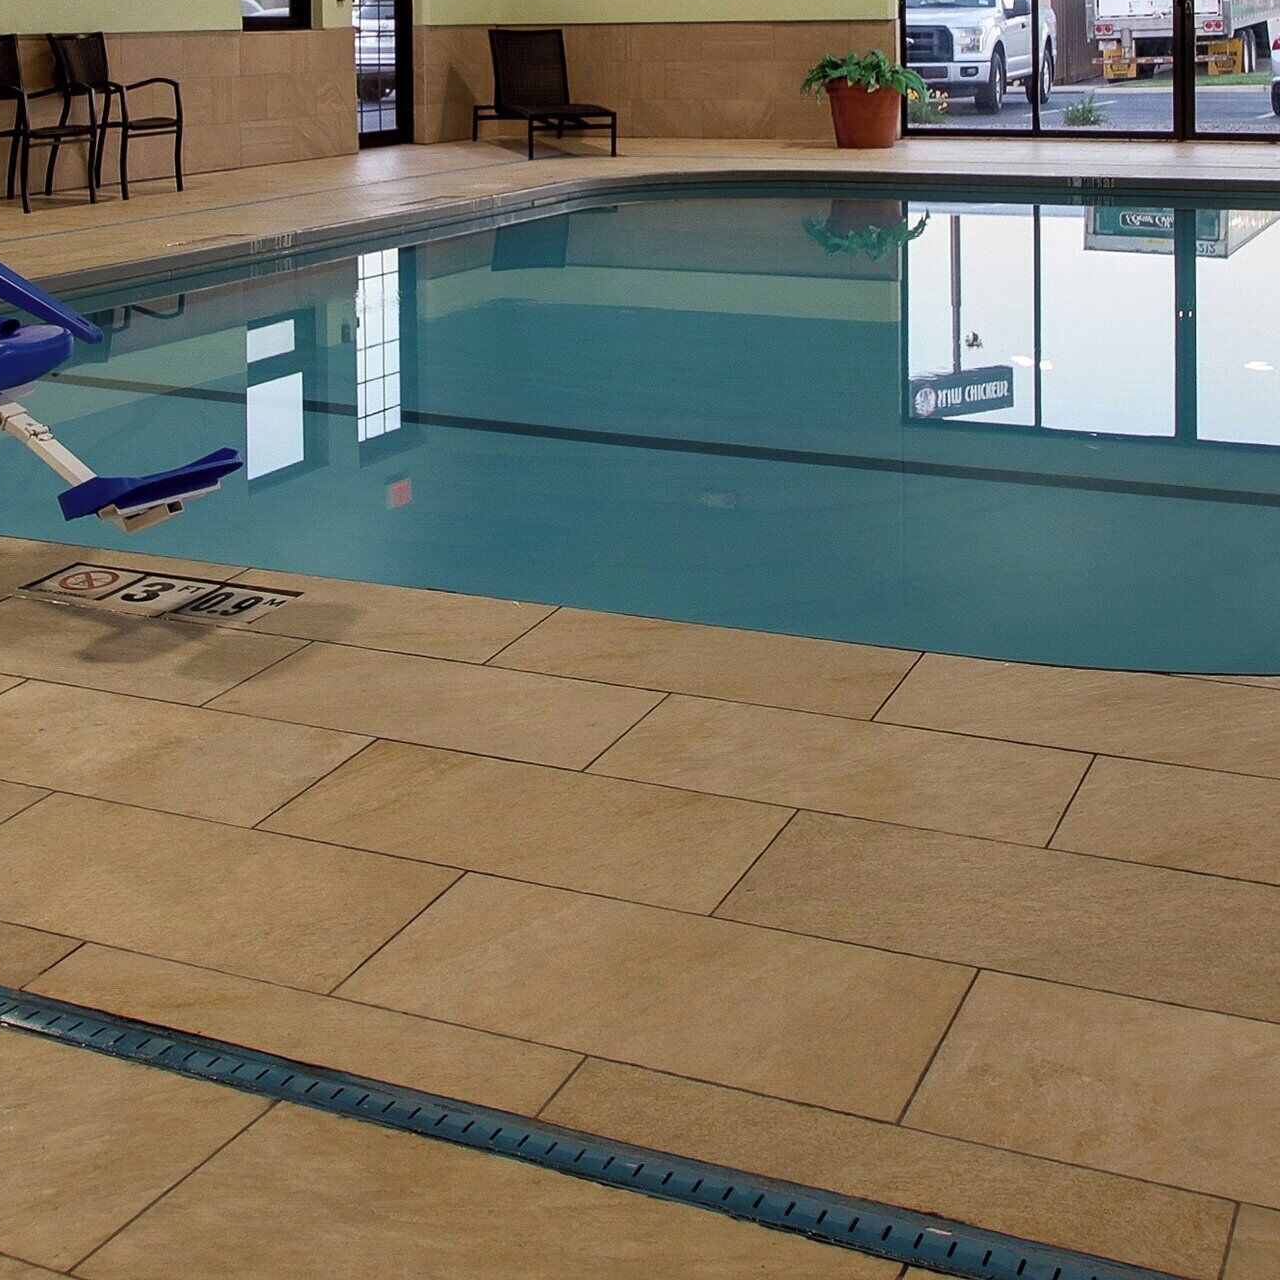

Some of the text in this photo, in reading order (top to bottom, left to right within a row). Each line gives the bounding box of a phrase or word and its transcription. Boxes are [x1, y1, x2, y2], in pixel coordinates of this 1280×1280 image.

[120, 582, 287, 616] 3 FT 0.9 M
